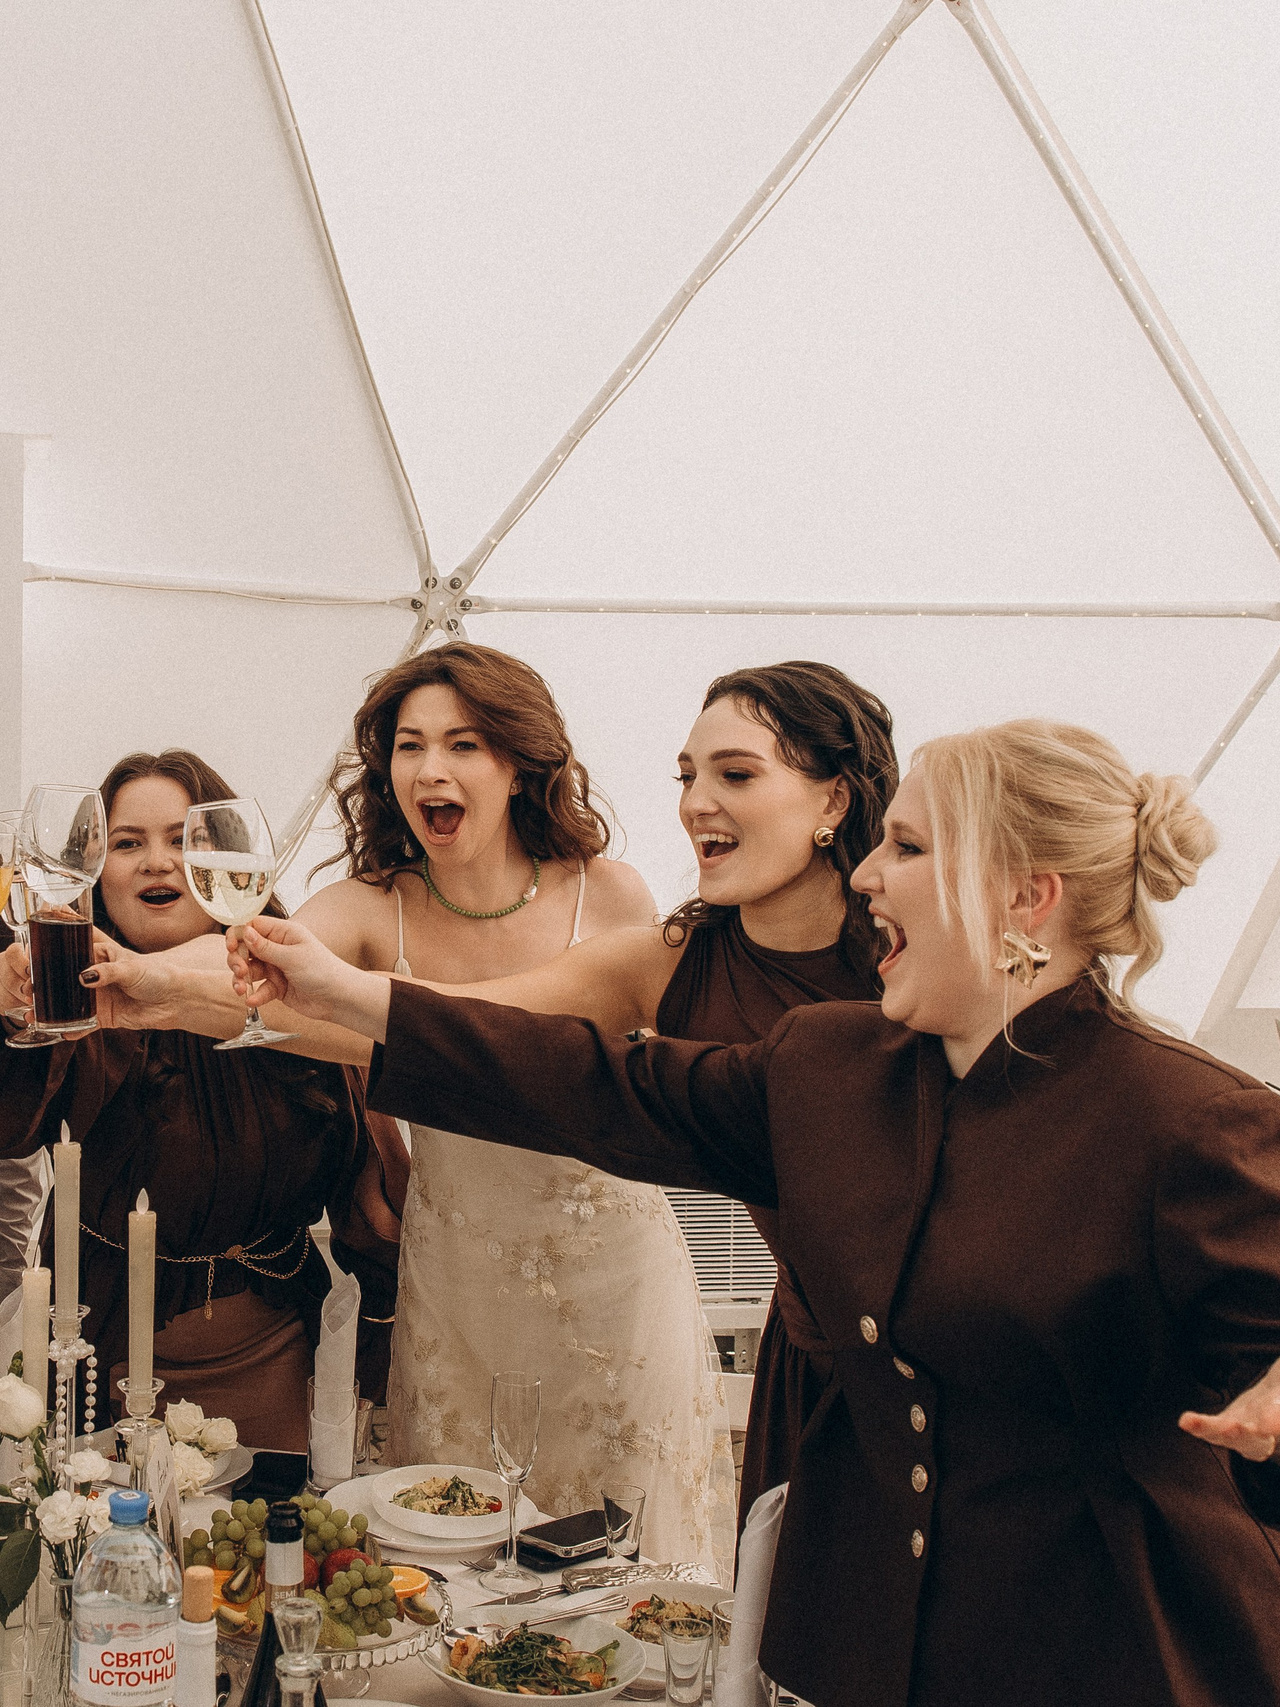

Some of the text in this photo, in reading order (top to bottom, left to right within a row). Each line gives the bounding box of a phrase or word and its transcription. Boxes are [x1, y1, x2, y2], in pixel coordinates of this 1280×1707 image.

[274, 1589, 296, 1600] SEMI
[100, 1641, 175, 1668] СВЯТОЙ
[89, 1661, 177, 1687] ИСТОЧНИ
